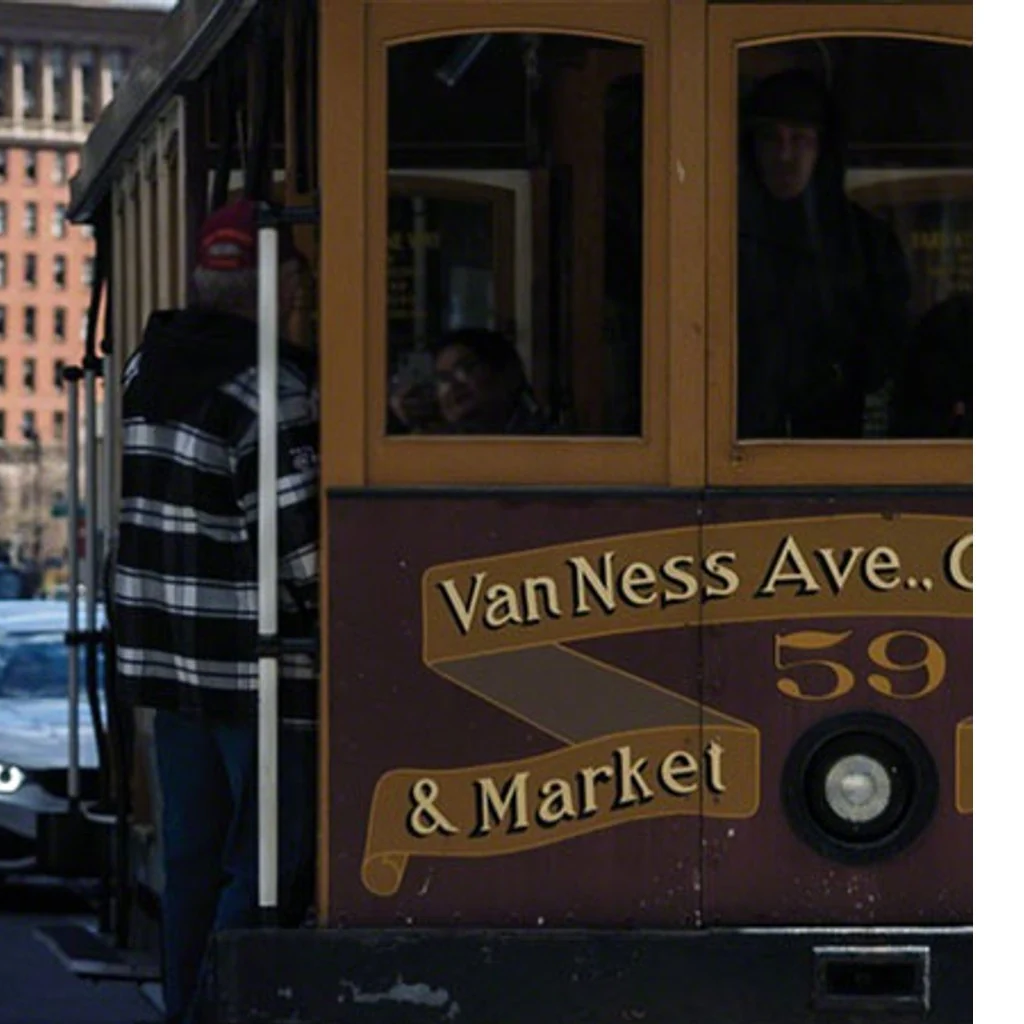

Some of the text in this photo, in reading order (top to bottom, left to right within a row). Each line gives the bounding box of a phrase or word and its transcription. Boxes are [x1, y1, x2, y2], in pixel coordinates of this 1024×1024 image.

[438, 571, 562, 635] Van
[568, 551, 740, 614] Ness
[775, 629, 946, 700] 59
[407, 740, 726, 838] & Market
